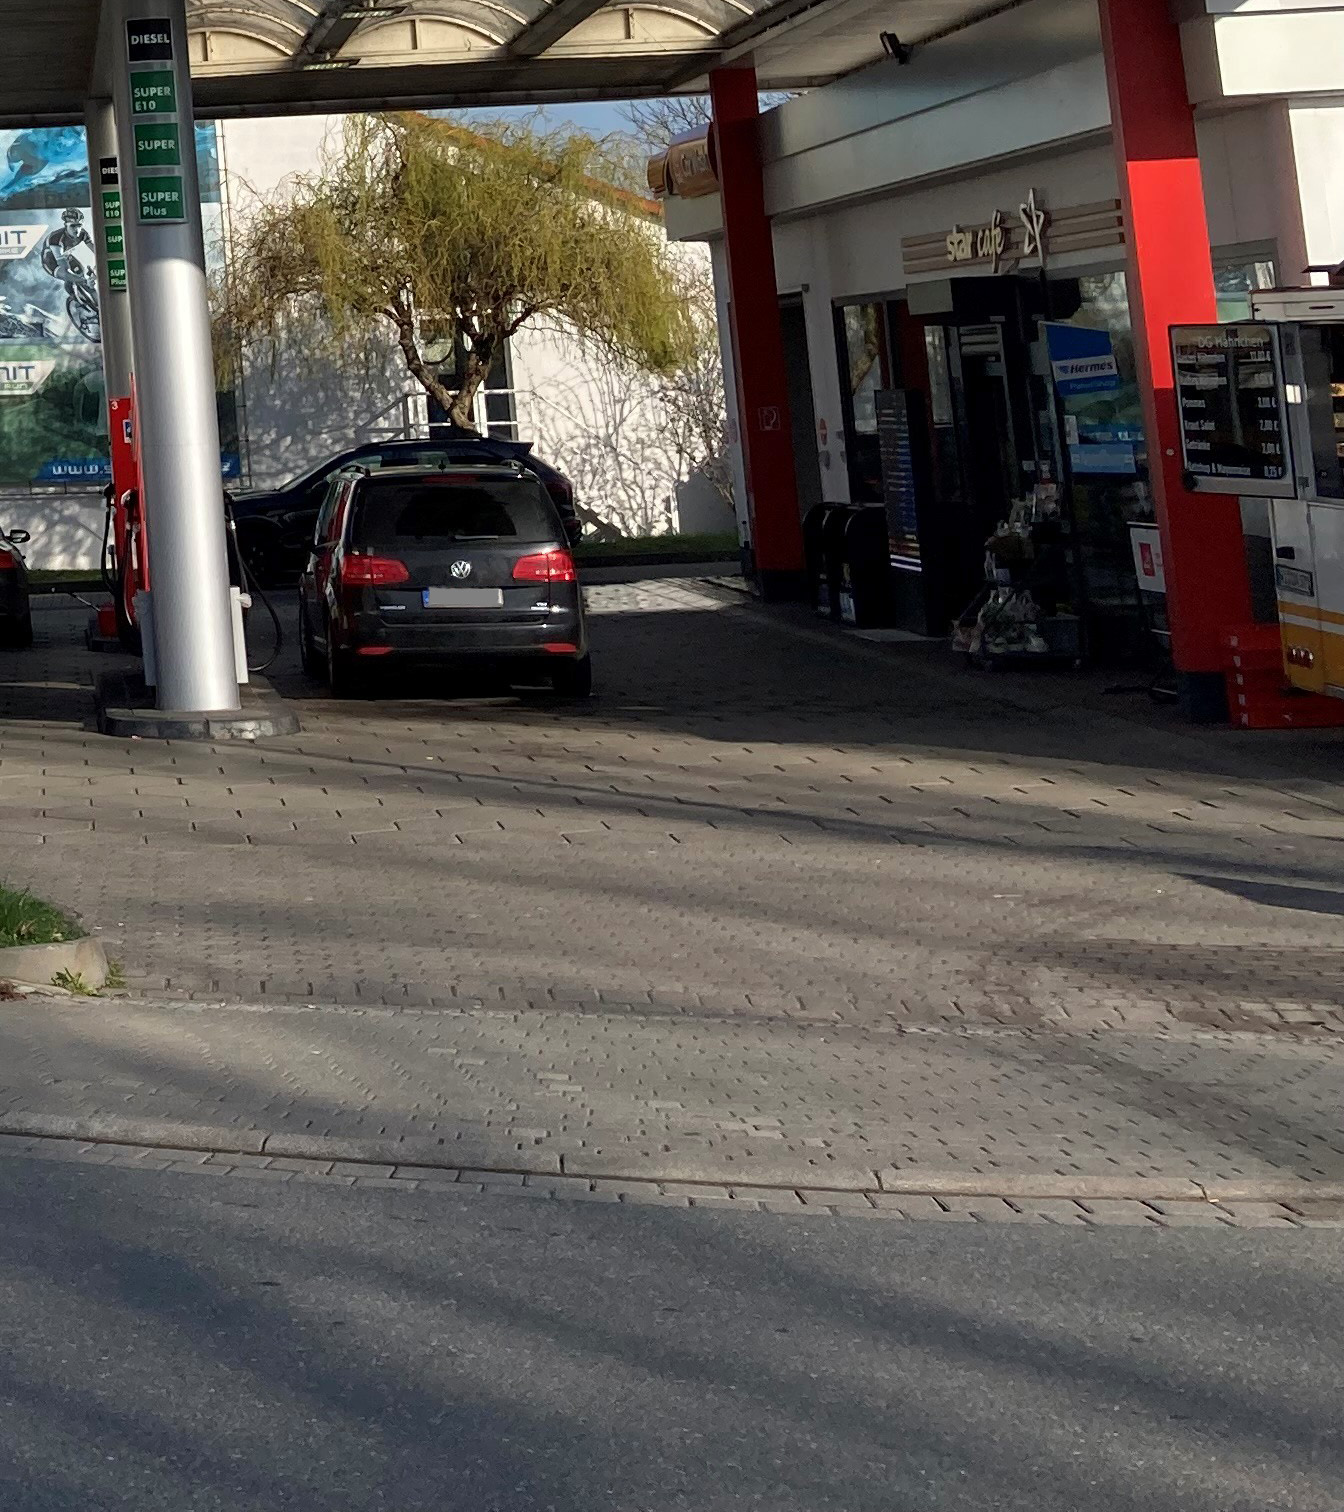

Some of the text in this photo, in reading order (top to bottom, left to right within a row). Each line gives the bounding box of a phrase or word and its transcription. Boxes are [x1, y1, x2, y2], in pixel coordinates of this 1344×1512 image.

[131, 33, 170, 45] DIESEL
[134, 86, 172, 98] SUPER
[135, 100, 156, 111] E10
[138, 139, 176, 150] SUPER
[141, 191, 179, 202] SUPER
[143, 206, 167, 217] Plus
[946, 209, 1005, 274] star café
[1070, 360, 1114, 374] Hermes
